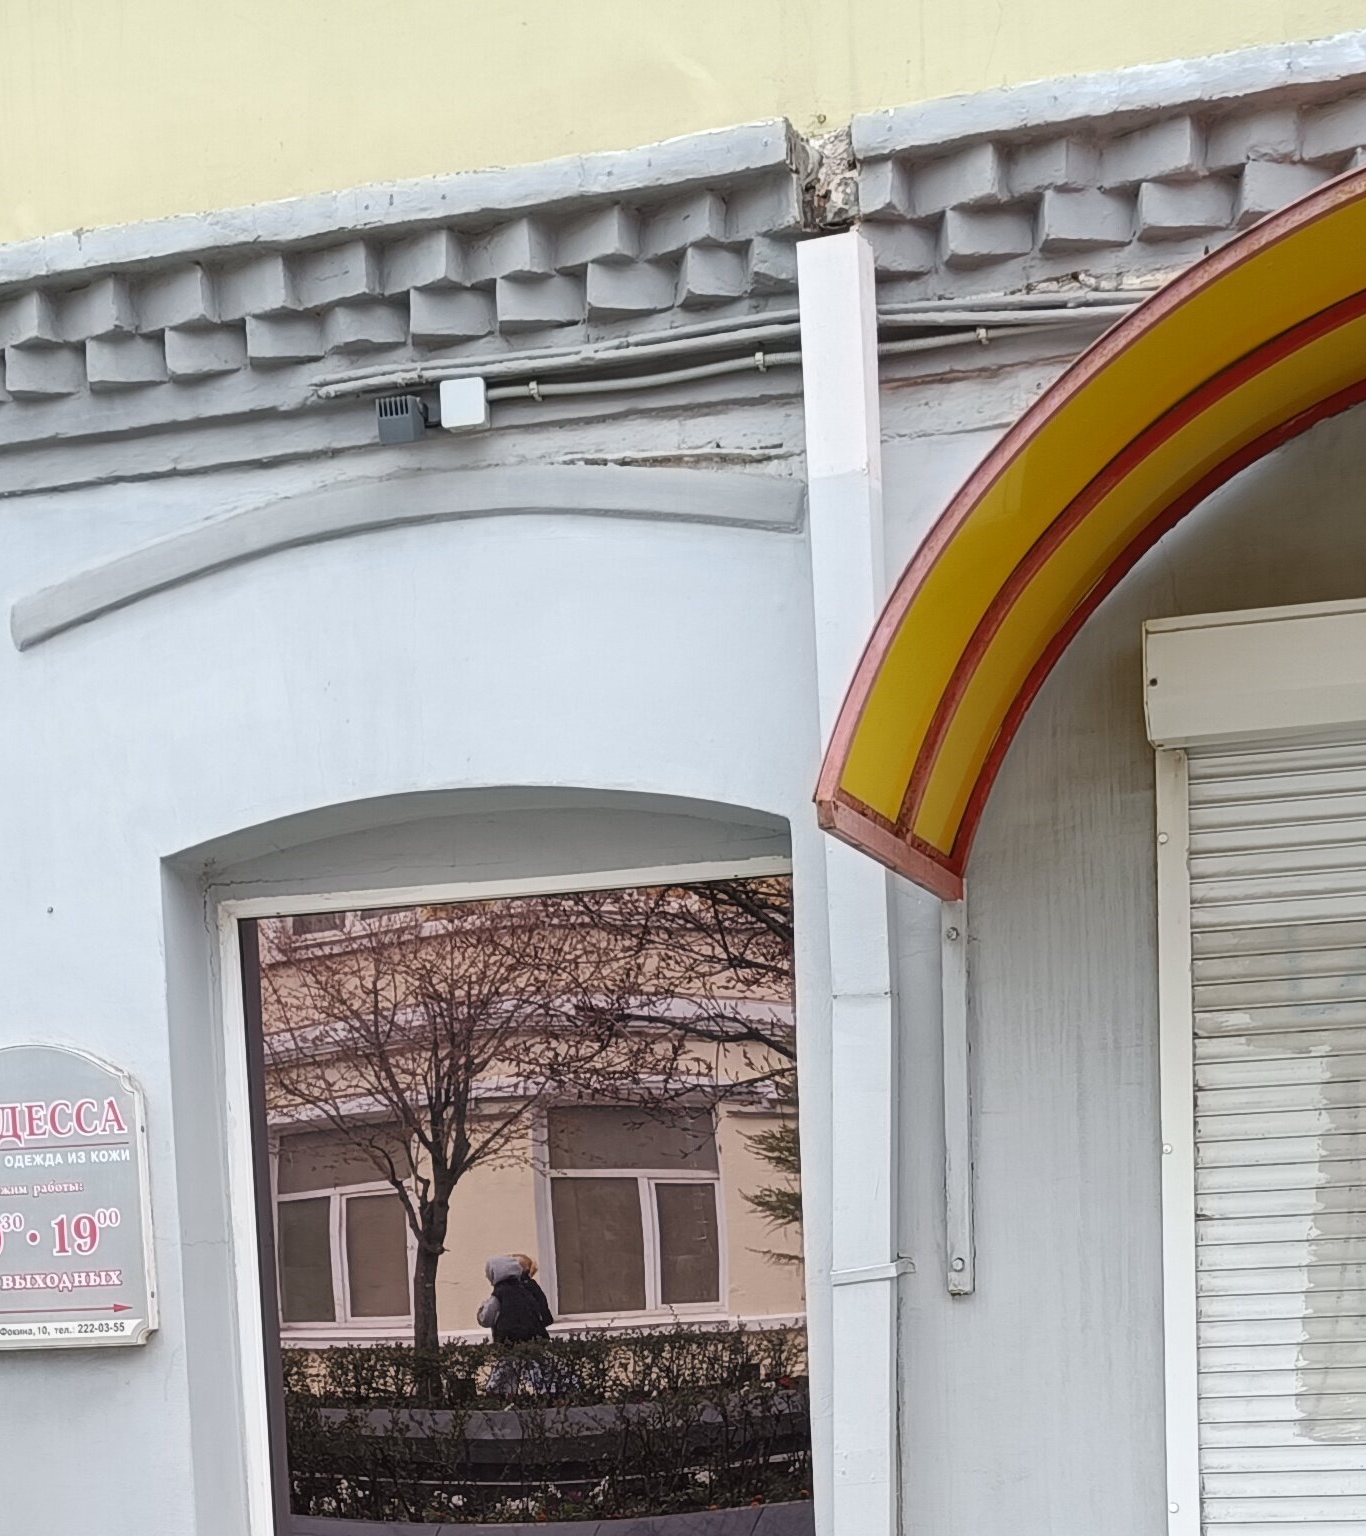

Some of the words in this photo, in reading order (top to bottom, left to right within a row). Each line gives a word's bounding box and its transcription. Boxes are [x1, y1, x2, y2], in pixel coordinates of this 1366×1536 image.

[4, 1153, 63, 1169] ОДЕЖДА
[67, 1152, 86, 1164] ИЗ
[90, 1149, 131, 1163] КОЖИ
[33, 1180, 84, 1198] работы:
[0, 1269, 123, 1292] выходных
[77, 1322, 125, 1334] 222-03-55
